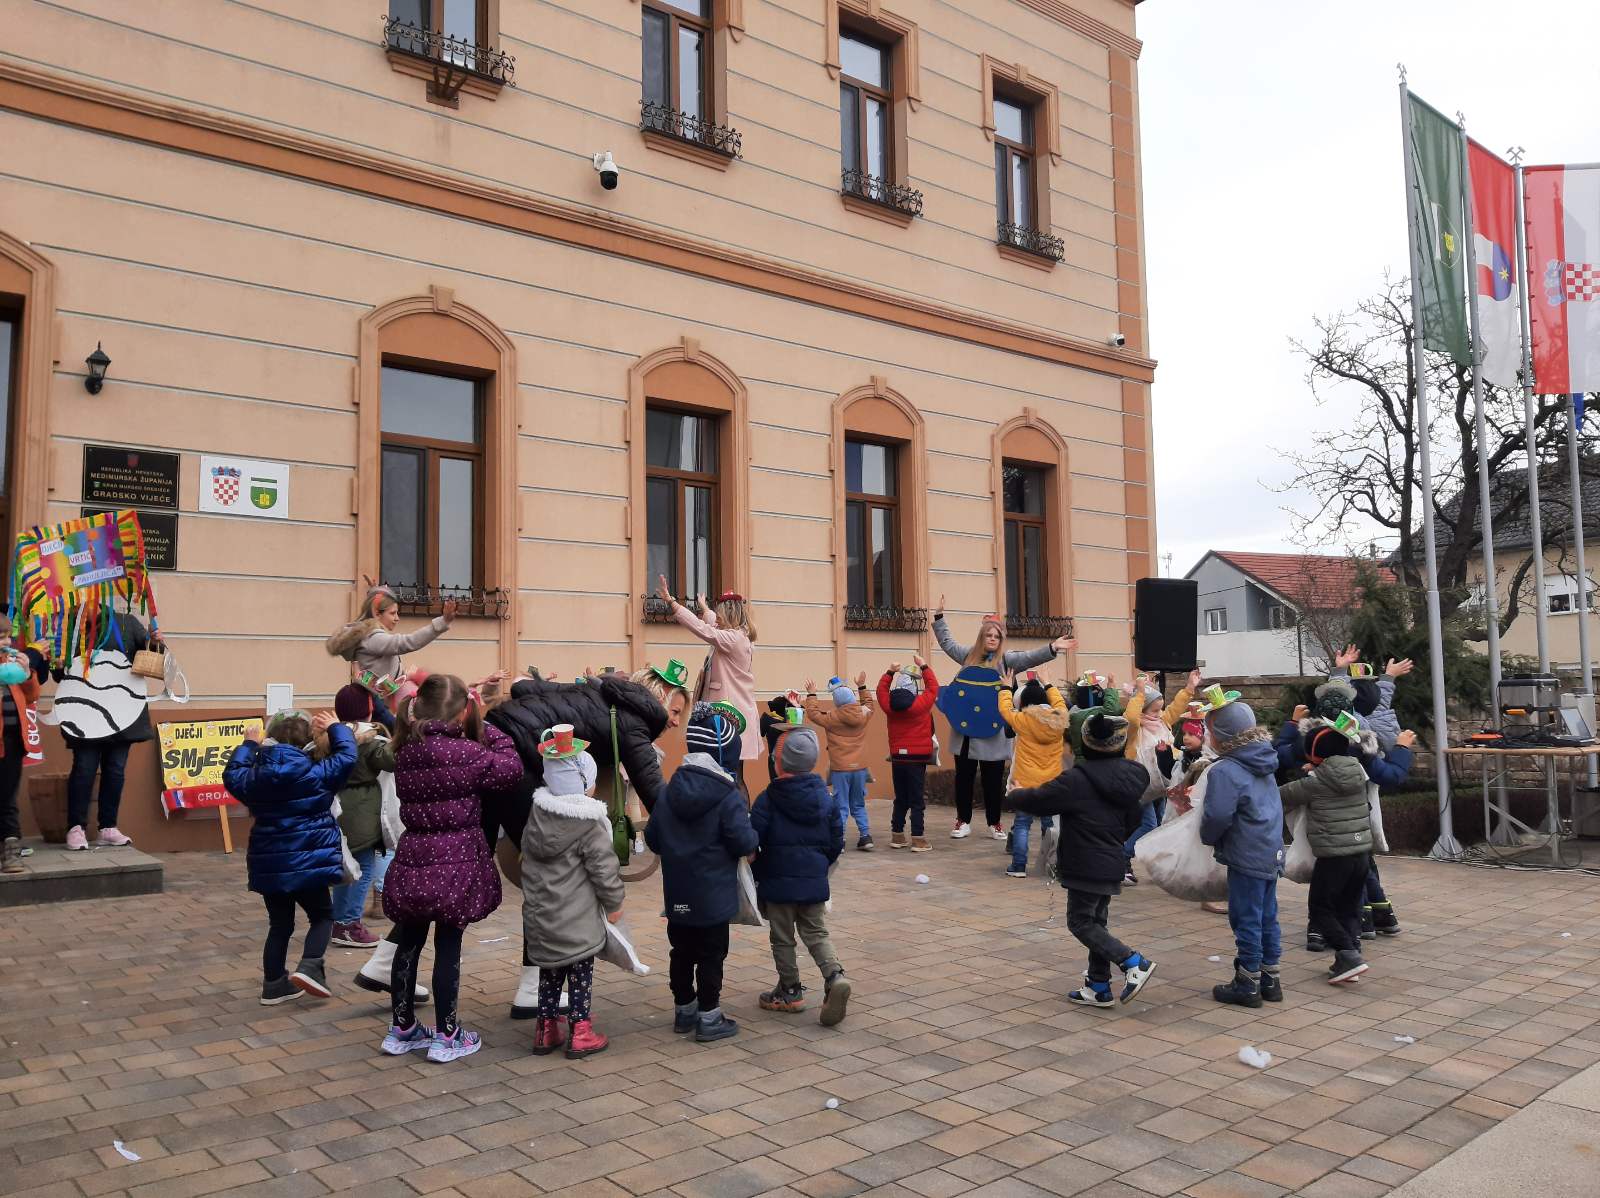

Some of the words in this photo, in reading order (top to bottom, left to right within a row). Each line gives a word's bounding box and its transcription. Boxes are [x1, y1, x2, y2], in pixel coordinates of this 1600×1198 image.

[93, 490, 136, 499] GRADSKO
[175, 724, 203, 739] DJEČJI
[219, 721, 245, 736] VRTIĆ
[198, 791, 230, 801] CROA
